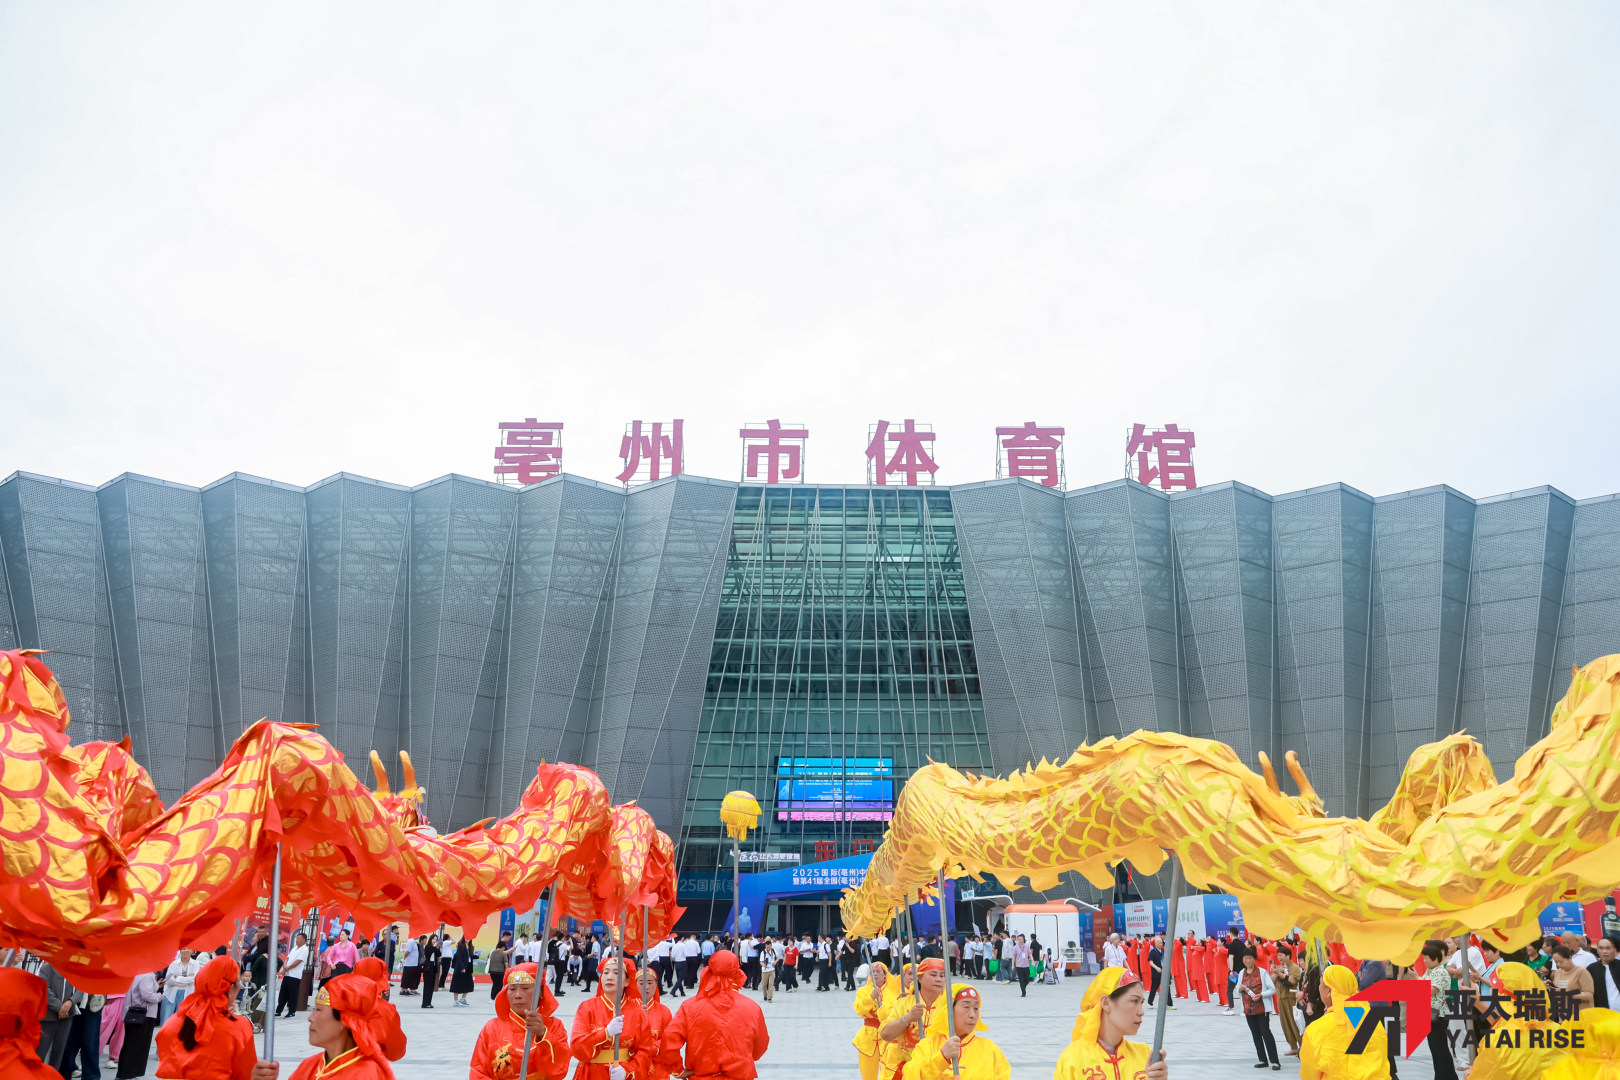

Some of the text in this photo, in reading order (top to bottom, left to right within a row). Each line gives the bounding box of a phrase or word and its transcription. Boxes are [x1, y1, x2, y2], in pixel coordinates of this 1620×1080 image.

[494, 417, 1197, 490] 亳州市体育馆
